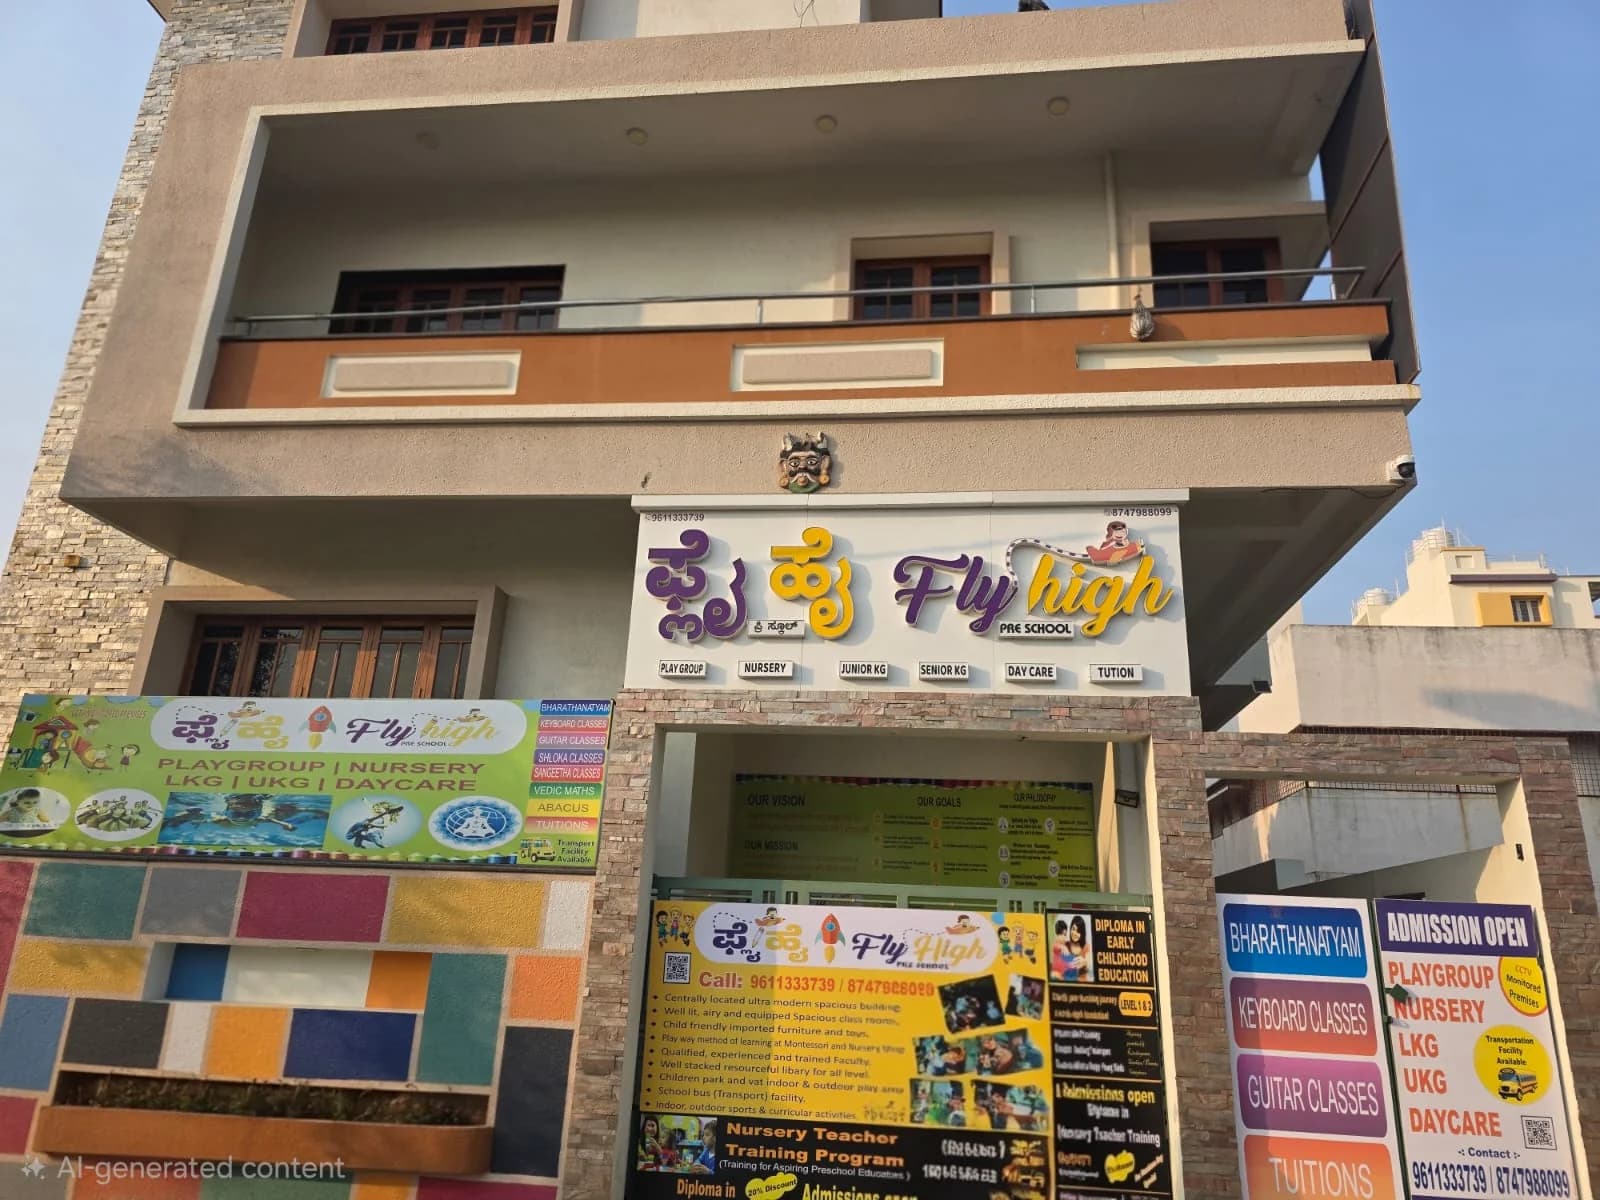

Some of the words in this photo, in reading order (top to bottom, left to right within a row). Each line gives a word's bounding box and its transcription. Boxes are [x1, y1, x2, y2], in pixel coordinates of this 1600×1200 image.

[651, 513, 704, 522] 9611333739
[1112, 507, 1171, 517] 8747988099
[770, 527, 854, 639] ಹೈ
[894, 553, 1018, 635] Fly
[1028, 554, 1172, 637] high
[1000, 623, 1021, 635] PRE
[1025, 623, 1071, 635] SCHOOL
[660, 662, 678, 674] PLAY
[679, 663, 704, 675] GROUP
[744, 662, 786, 673] NURSERY
[841, 663, 872, 674] JUNIOR
[873, 664, 886, 675] KG
[920, 664, 953, 676] SENIOR
[954, 665, 967, 677] KG
[1008, 666, 1028, 677] DAY
[1029, 666, 1053, 678] CARE
[1098, 667, 1134, 679] TUTION
[541, 703, 610, 712] BHARATHANATYAM
[540, 719, 576, 728] KEYBOARD
[577, 719, 607, 729] CLASSES
[346, 718, 416, 747] Fly
[420, 719, 498, 747] high
[538, 736, 568, 745] GUITAR
[569, 736, 606, 746] CLASSES
[538, 752, 568, 763] SHLOKA
[569, 752, 603, 764] CLASSES
[158, 758, 326, 774] PLAYGROUP
[349, 761, 486, 775] NURSERY
[534, 767, 571, 778] SANGEETHA
[572, 768, 601, 779] CLASSES
[165, 775, 224, 787] LKG
[248, 776, 310, 789] UKG
[335, 777, 477, 791] DAYCARE
[534, 785, 562, 795] VEDIC
[564, 785, 595, 795] MATHS
[537, 802, 589, 813] ABACUS
[747, 795, 769, 807] OUR
[772, 795, 805, 807] VISION
[917, 796, 932, 808] OUR
[935, 797, 962, 808] GOALS
[536, 820, 589, 831] TUITIONS
[557, 839, 595, 848] Transport
[561, 847, 589, 856] Facility
[557, 855, 592, 864] Available
[1095, 918, 1134, 933] DIPLOMA
[1135, 920, 1146, 934] IN
[1387, 912, 1483, 946] ADMISSION
[1483, 914, 1529, 948] OPEN
[765, 923, 809, 963] ಹೈ
[852, 932, 908, 964] Fly
[1107, 935, 1135, 949] EARLY
[1230, 922, 1362, 958] BHARATHANATYAM
[1097, 951, 1148, 967] CHILDHOOD
[1098, 967, 1149, 984] EDUCATION
[1388, 961, 1494, 989] PLAYGROUP
[1515, 964, 1533, 976] CCTV
[700, 971, 743, 989] Call:
[750, 974, 836, 992] 9611333739
[1506, 973, 1542, 994] Monitored
[665, 993, 706, 1005] Centrally
[710, 994, 745, 1005] located
[748, 997, 771, 1006] ultra
[773, 999, 812, 1008] modern
[814, 1001, 857, 1011] spacious
[1120, 1000, 1138, 1011] LEVEL
[1509, 989, 1540, 1010] Premises
[664, 1007, 686, 1016] Well
[703, 1008, 720, 1018] airy
[723, 1009, 742, 1018] and
[744, 1010, 791, 1021] equipped
[793, 1013, 836, 1023] Spacious
[1238, 996, 1307, 1031] KEYBOARD
[1309, 1000, 1368, 1035] CLASSES
[1394, 996, 1485, 1024] NURSERY
[663, 1020, 688, 1030] Child
[690, 1021, 727, 1032] friendly
[730, 1023, 775, 1033] imported
[777, 1025, 822, 1035] furniture
[824, 1027, 843, 1036] and
[662, 1033, 677, 1044] Play
[680, 1035, 695, 1045] way
[697, 1034, 726, 1045] method
[729, 1035, 738, 1045] of
[741, 1036, 772, 1048] learning
[784, 1039, 829, 1049] Montessori
[831, 1042, 847, 1051] and
[1399, 1031, 1439, 1059] LKG
[1485, 1035, 1534, 1045] Transportation
[661, 1047, 708, 1059] Qualified,
[710, 1049, 771, 1061] experienced
[773, 1052, 792, 1062] and
[795, 1054, 831, 1064] trained
[1498, 1046, 1523, 1056] Facility
[660, 1060, 682, 1069] Well
[684, 1061, 721, 1071] stacked
[723, 1063, 780, 1074] resourceful
[782, 1066, 810, 1078] libary
[813, 1067, 827, 1077] for
[830, 1068, 841, 1077] all
[1496, 1057, 1527, 1067] Available
[659, 1071, 700, 1082] Children
[702, 1074, 724, 1085] park
[727, 1076, 746, 1086] and
[748, 1077, 764, 1087] vat
[766, 1078, 799, 1088] indoor
[802, 1080, 811, 1089] &
[813, 1081, 854, 1091] outdoor
[1404, 1067, 1448, 1095] UKG
[658, 1086, 691, 1097] School
[693, 1087, 711, 1097] bus
[713, 1089, 768, 1102] (Transport)
[1127, 1090, 1156, 1107] open
[1248, 1074, 1305, 1112] GUITAR
[1307, 1078, 1379, 1116] CLASSES
[655, 1101, 687, 1112] Indoor,
[689, 1102, 726, 1112] outdoor
[728, 1105, 756, 1116] sports
[758, 1105, 766, 1114] &
[769, 1106, 812, 1118] curricular
[815, 1109, 856, 1120] activities
[1409, 1107, 1503, 1138] DAYCARE
[726, 1122, 808, 1142] Nursery
[813, 1127, 899, 1145] Teacher
[1127, 1129, 1161, 1148] Training
[725, 1143, 808, 1164] Training
[815, 1148, 905, 1168] Program
[1468, 1147, 1512, 1160] Contact
[719, 1159, 757, 1171] (Training
[760, 1160, 771, 1171] for
[774, 1162, 809, 1174] Aspiring
[811, 1164, 856, 1177] Preschool
[765, 1179, 797, 1193] Discount
[1268, 1157, 1374, 1199] TUITIONS
[1412, 1160, 1488, 1194] 9611333739
[1496, 1166, 1571, 1199] 8747988099
[676, 1178, 723, 1199] Diploma
[725, 1180, 736, 1198] in
